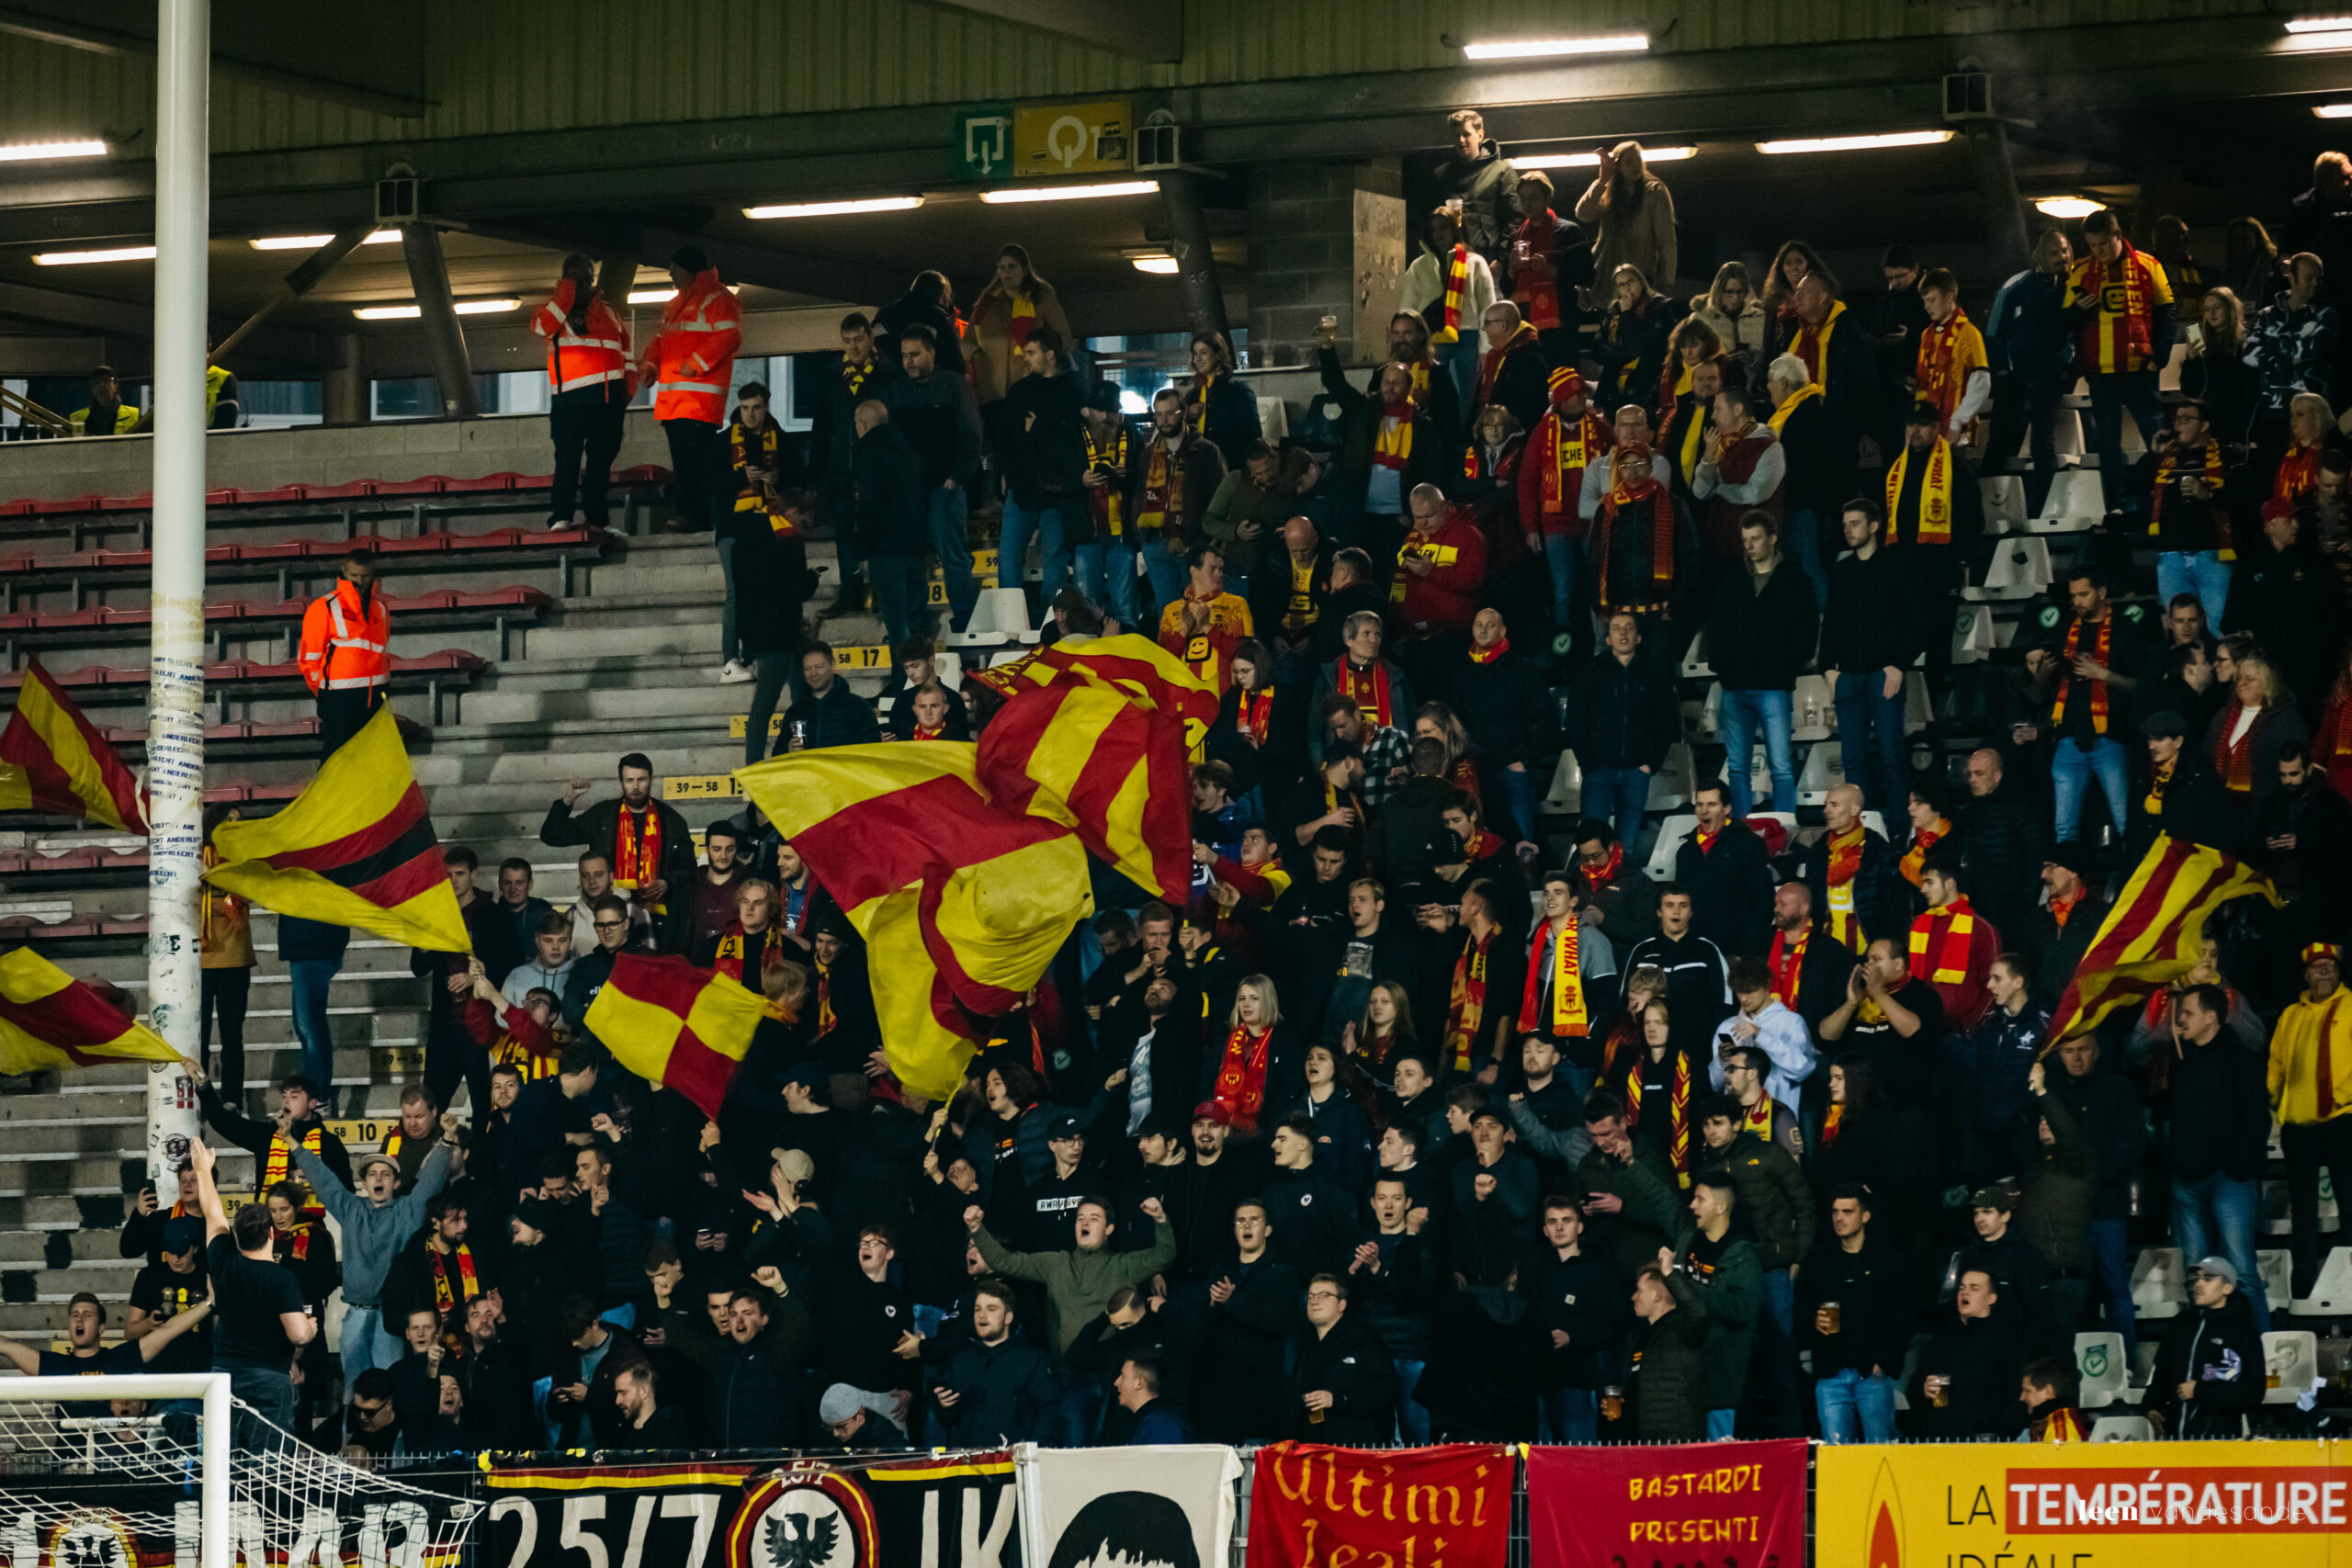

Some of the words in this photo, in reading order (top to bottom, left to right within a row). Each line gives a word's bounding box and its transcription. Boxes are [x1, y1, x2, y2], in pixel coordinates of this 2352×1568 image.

[839, 653, 851, 664] 58
[862, 649, 879, 667] 17
[676, 782, 690, 794] 39
[706, 781, 718, 792] 58
[1564, 935, 1578, 978] WHAT
[334, 1126, 346, 1138] 58
[357, 1122, 377, 1142] 10
[227, 1200, 241, 1212] 39
[1629, 1464, 1763, 1502] BASTARDI
[1947, 1484, 1996, 1526] LA
[2009, 1470, 2347, 1526] TEMPÉRATURE
[1629, 1516, 1759, 1543] PRESENTI
